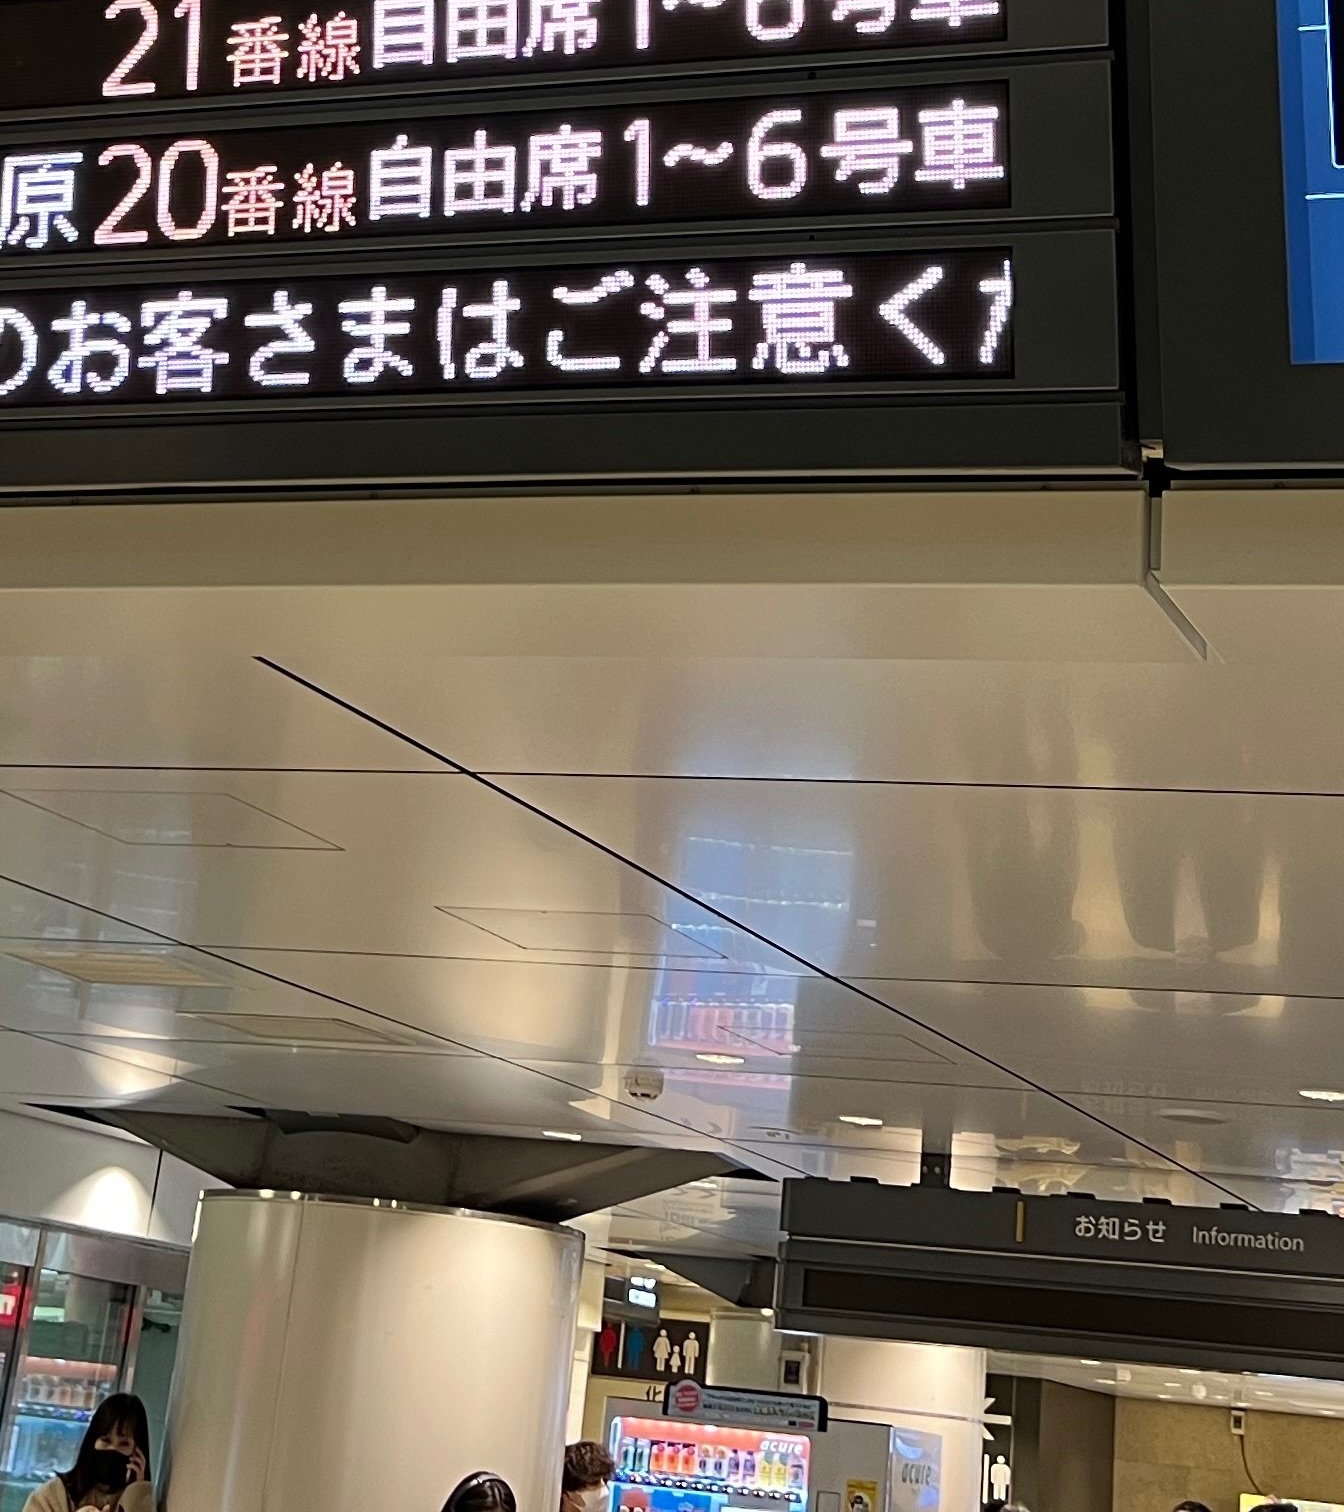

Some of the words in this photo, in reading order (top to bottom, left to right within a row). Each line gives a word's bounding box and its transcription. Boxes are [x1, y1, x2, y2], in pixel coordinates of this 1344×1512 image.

[93, 140, 357, 245] 20番線
[1074, 1214, 1167, 1244] お知らせ
[1192, 1225, 1305, 1253] Information
[759, 1438, 804, 1456] acure
[901, 1460, 933, 1487] acure
